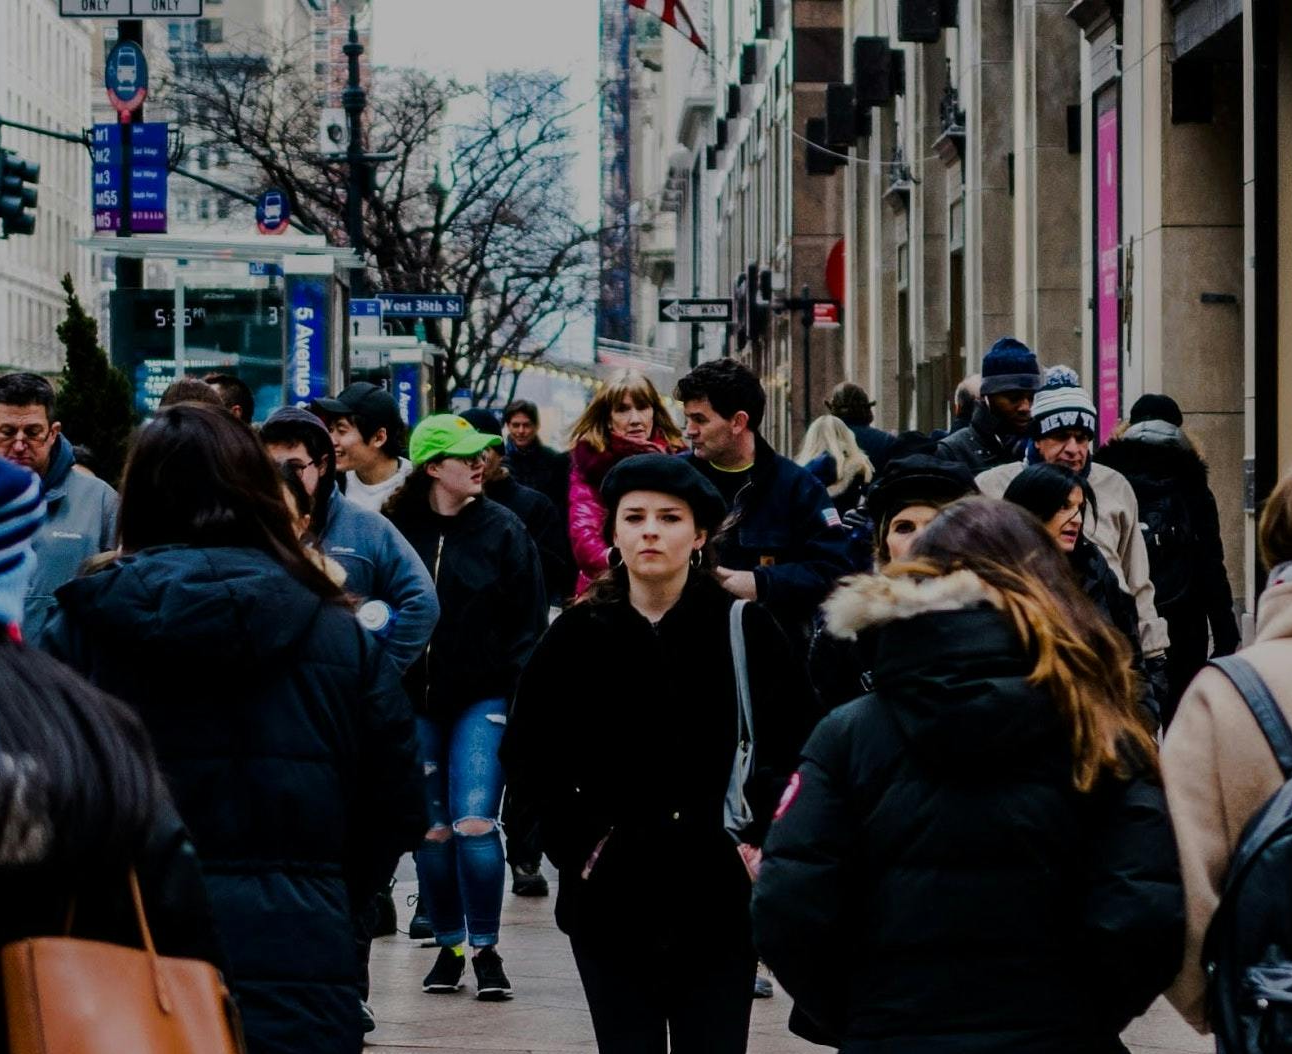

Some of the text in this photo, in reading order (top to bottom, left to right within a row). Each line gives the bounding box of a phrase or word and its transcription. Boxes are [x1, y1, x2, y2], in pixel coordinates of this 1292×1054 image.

[81, 0, 109, 11] ONLY
[151, 0, 179, 11] ONLY
[95, 127, 109, 142] M1
[95, 147, 111, 163] M2
[95, 169, 111, 185] M3
[95, 190, 118, 206] M55
[96, 212, 111, 228] M5
[382, 298, 412, 312] West
[415, 299, 443, 312] 38th
[446, 300, 460, 312] St
[669, 303, 693, 315] ONE
[294, 307, 314, 320] 5
[294, 323, 314, 397] Avenue
[1040, 411, 1079, 434] NEW
